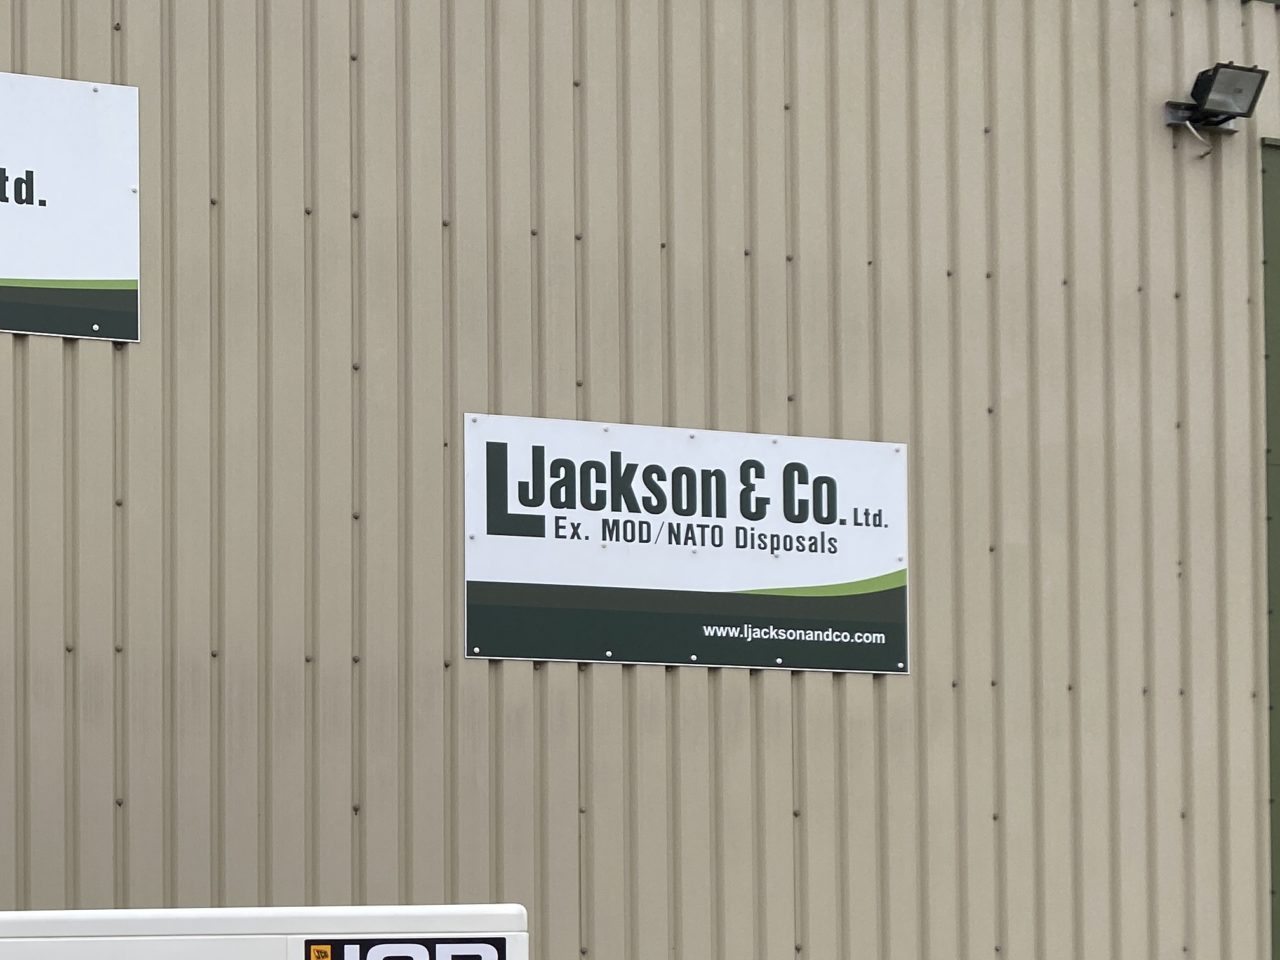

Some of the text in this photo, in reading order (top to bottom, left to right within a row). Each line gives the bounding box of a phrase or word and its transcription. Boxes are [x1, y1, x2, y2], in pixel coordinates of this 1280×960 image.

[739, 458, 771, 522] &
[782, 461, 848, 527] Co.
[852, 506, 889, 529] Ltd.
[553, 514, 839, 555] Ex. MOD/NATO Disposals
[702, 622, 887, 645] www.ljacksonandco.com
